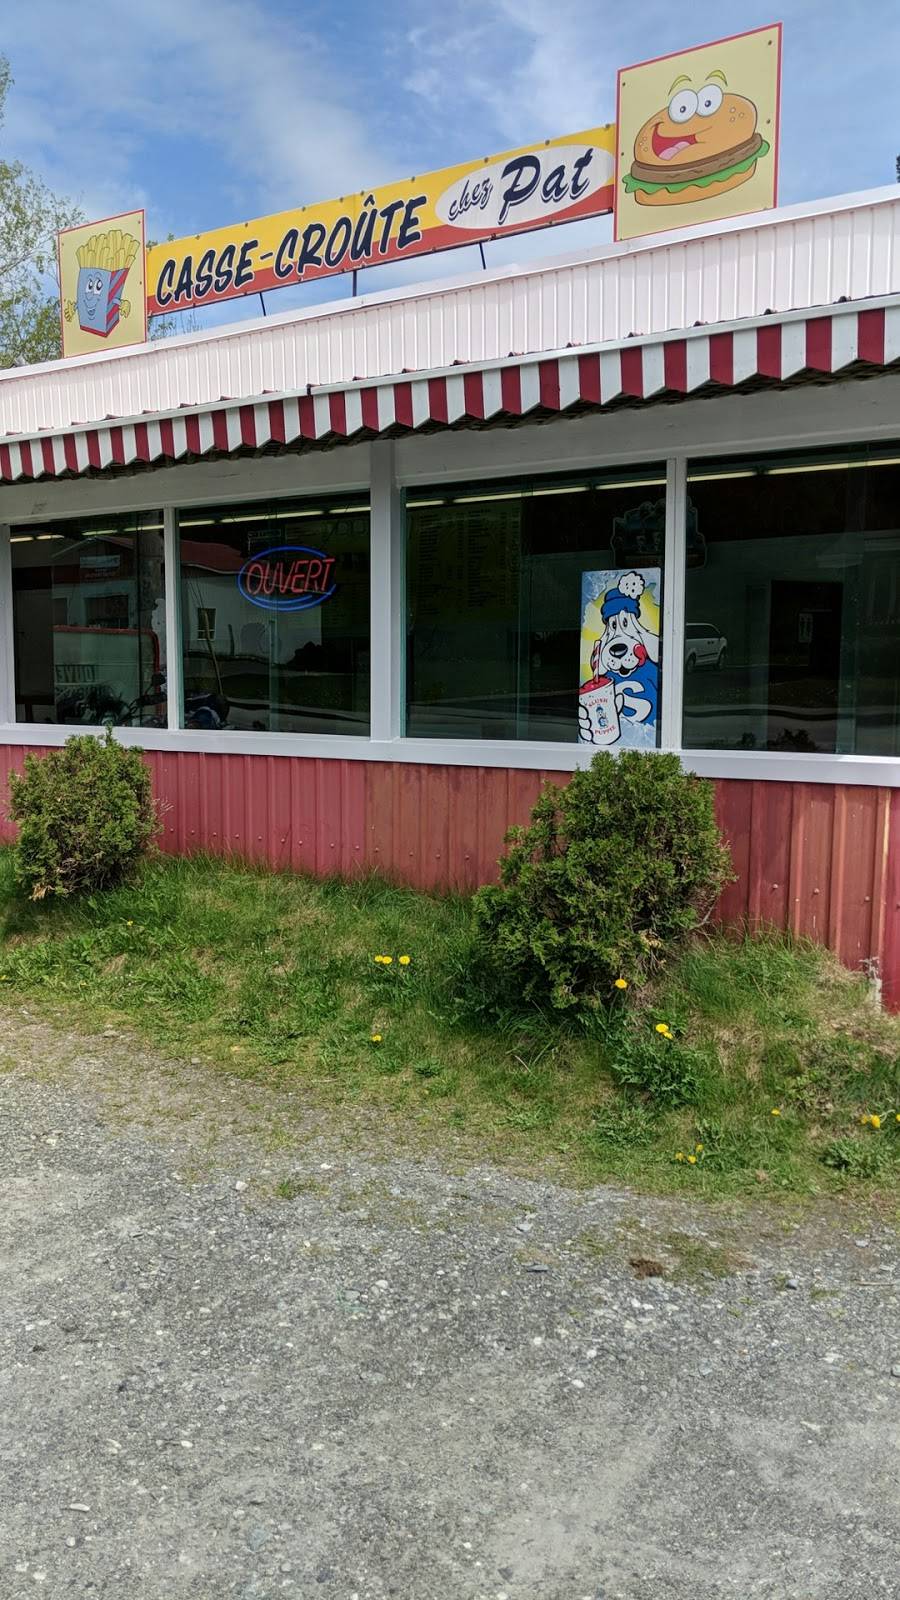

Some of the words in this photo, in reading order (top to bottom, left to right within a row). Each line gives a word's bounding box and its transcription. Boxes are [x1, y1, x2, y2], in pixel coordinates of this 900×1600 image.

[447, 176, 493, 220] chez
[498, 147, 594, 225] Pat
[156, 195, 428, 306] CASSE-CROÛTE
[247, 557, 336, 595] OUVERT
[614, 680, 653, 723] S
